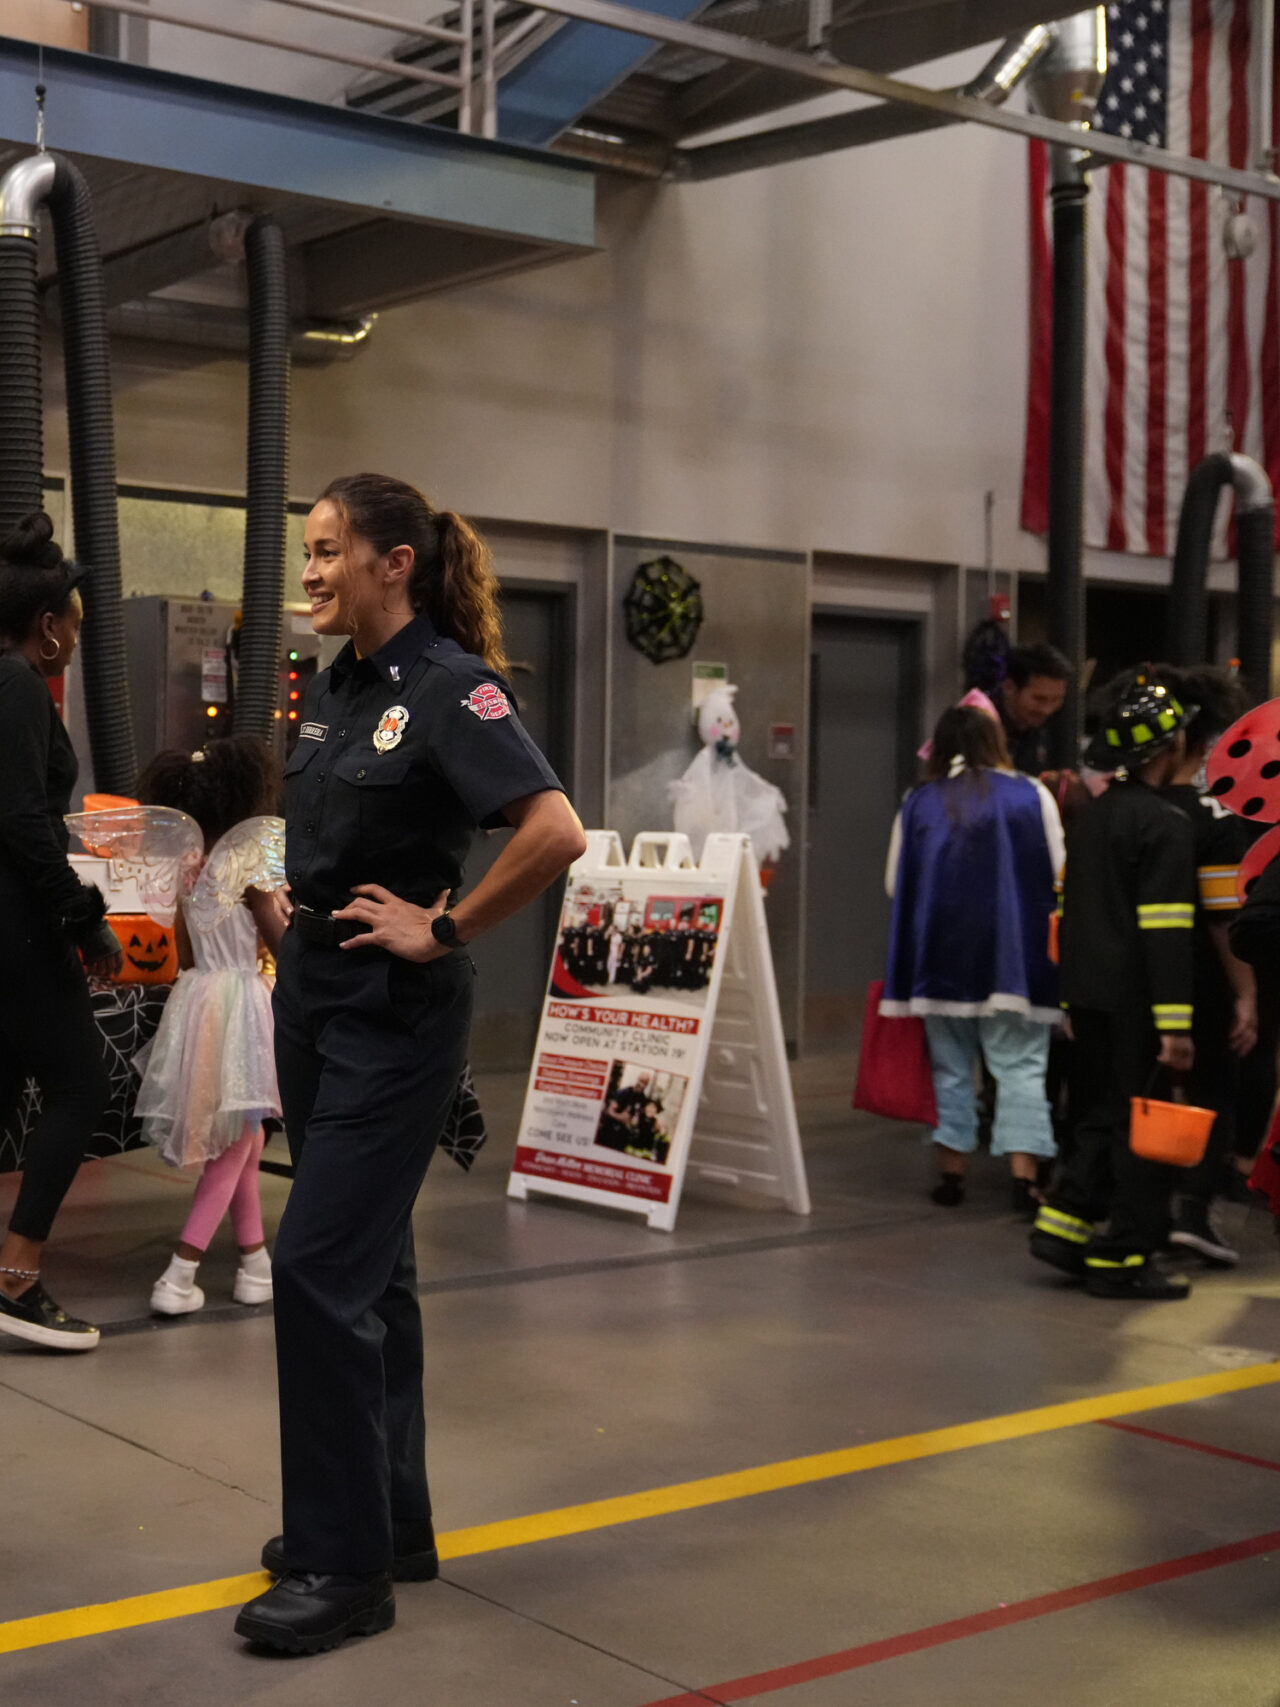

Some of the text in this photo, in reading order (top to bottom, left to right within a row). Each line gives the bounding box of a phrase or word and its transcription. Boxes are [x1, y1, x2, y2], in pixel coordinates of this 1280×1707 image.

[479, 686, 494, 694] FIRE
[550, 1004, 694, 1031] HOW'S YOUR HEALTH?
[544, 1032, 568, 1042] NOW
[572, 1035, 599, 1048] OPEN
[603, 1039, 617, 1049] AT
[620, 1042, 668, 1056] STATION
[565, 1023, 671, 1045] COMMUNITY CLINIC
[527, 1127, 552, 1140] COME
[556, 1131, 573, 1144] SEE
